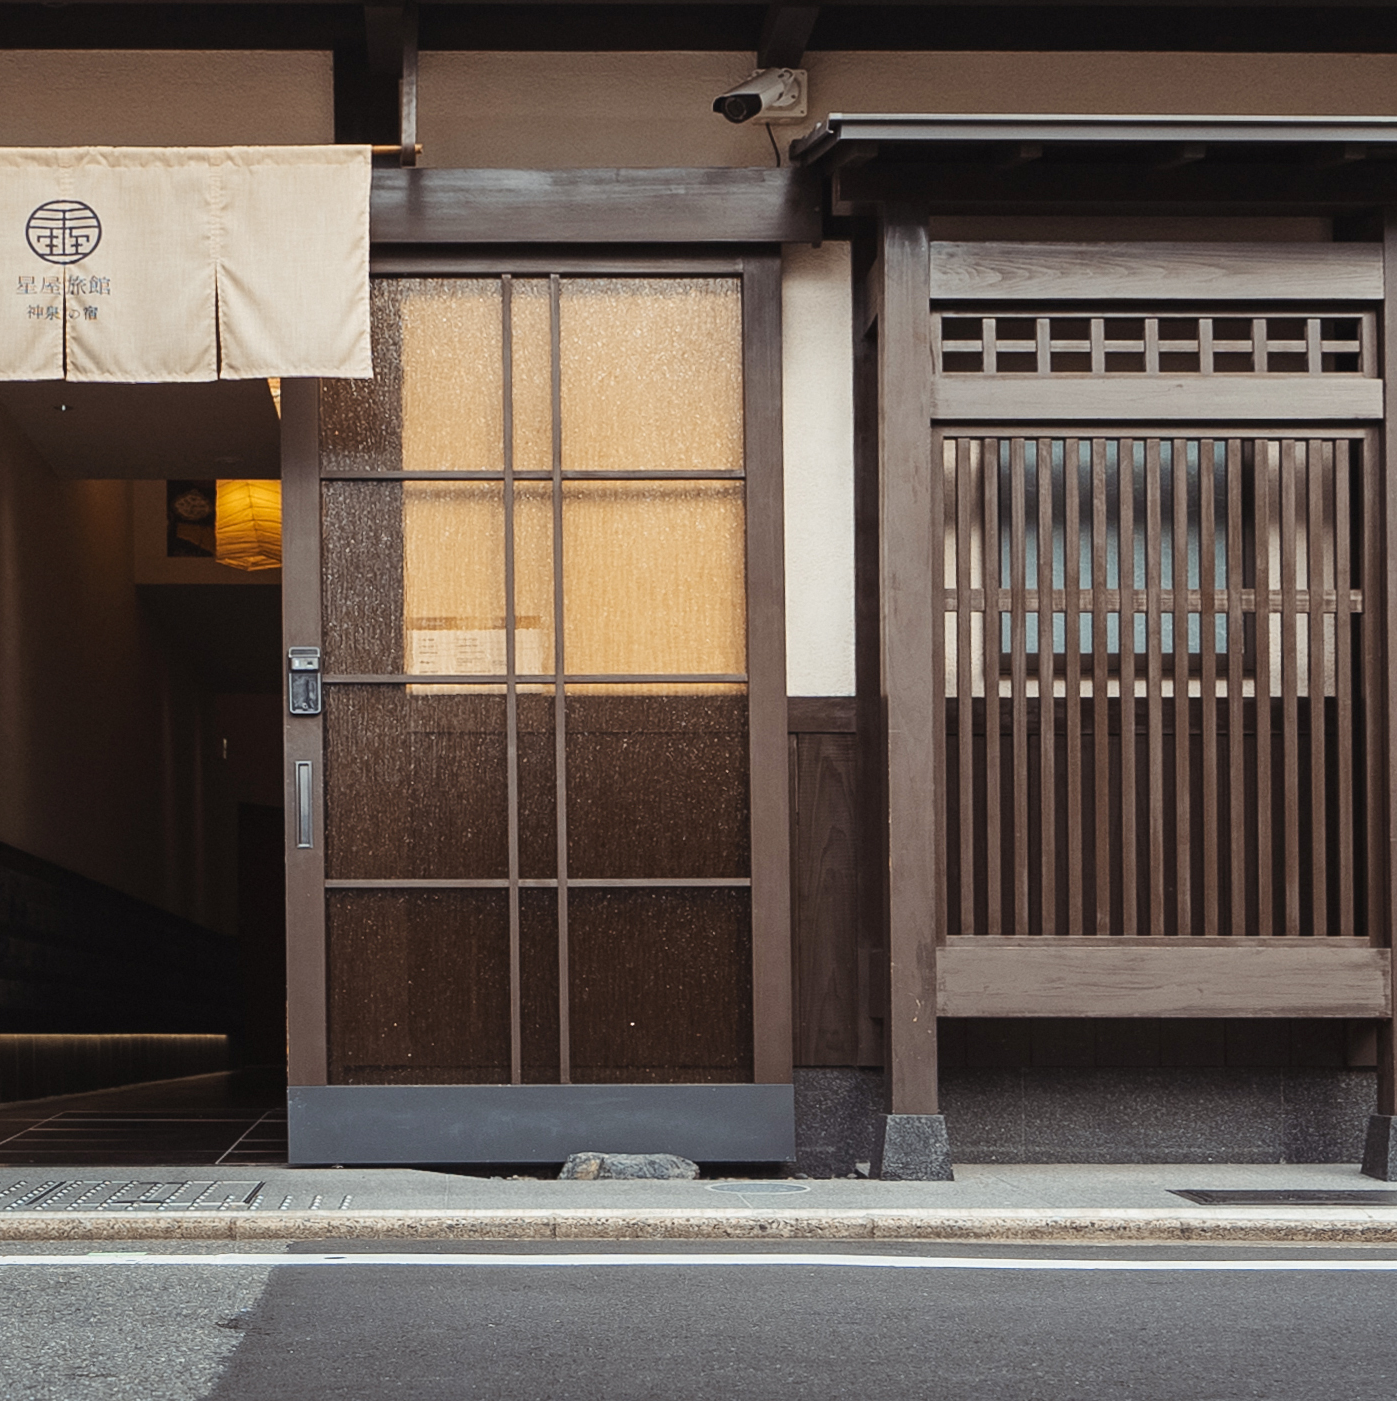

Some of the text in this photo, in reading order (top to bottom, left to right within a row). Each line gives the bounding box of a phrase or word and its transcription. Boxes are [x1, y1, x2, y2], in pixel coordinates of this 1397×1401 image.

[15, 274, 111, 296] 星屋旅館
[26, 303, 99, 321] 神泉の宿
